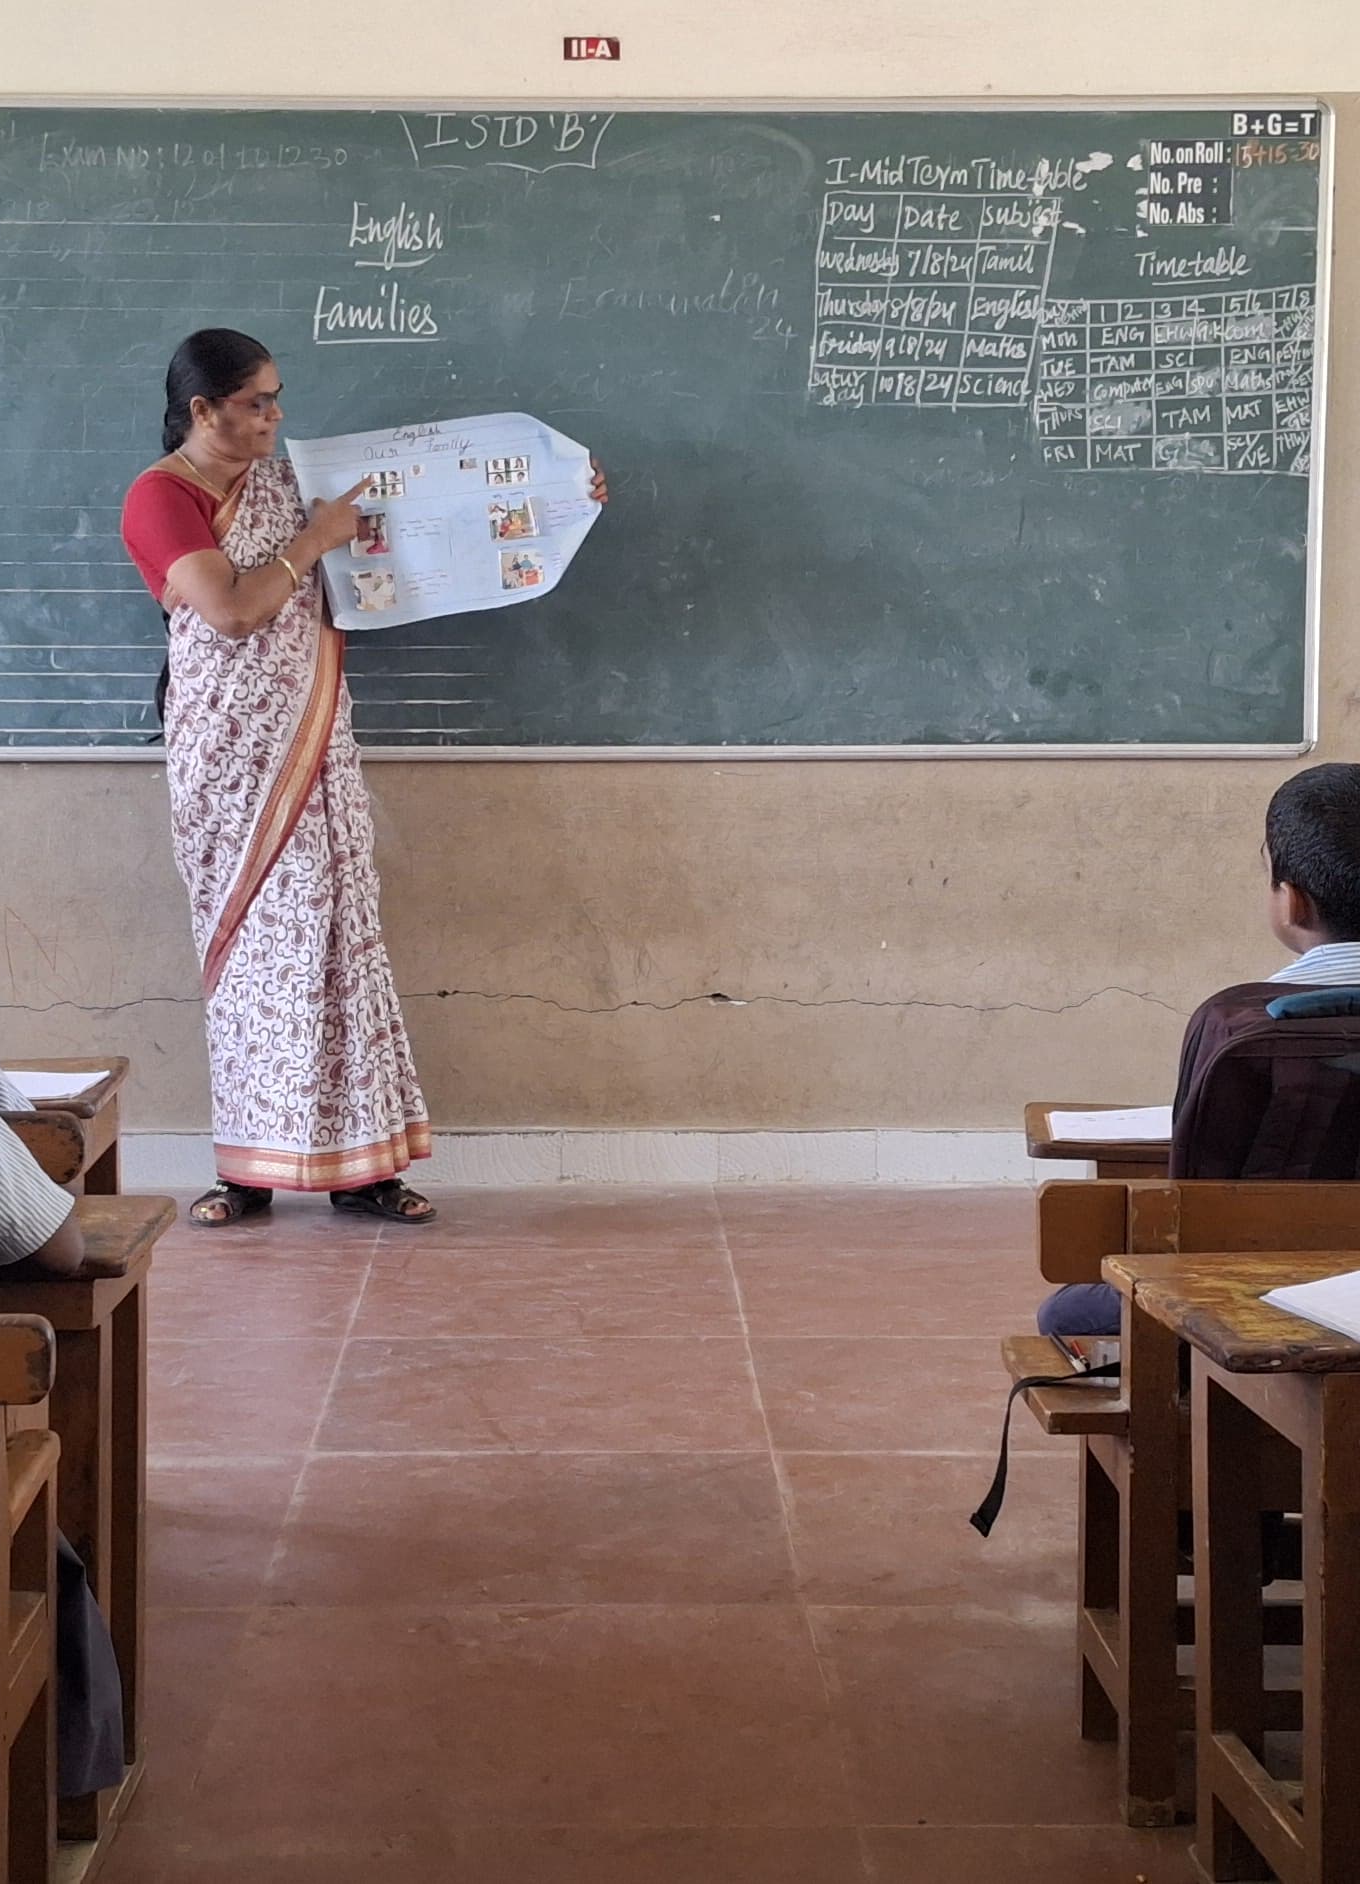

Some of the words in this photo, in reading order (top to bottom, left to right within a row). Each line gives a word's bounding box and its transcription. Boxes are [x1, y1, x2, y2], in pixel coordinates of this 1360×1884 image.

[571, 39, 613, 58] II-A
[465, 113, 539, 151] STD
[1176, 147, 1193, 164] on
[1177, 171, 1203, 195] Pre
[827, 202, 875, 232] Day
[904, 206, 964, 231] Date
[1176, 201, 1206, 224] Abs
[349, 200, 444, 271] English
[978, 244, 1035, 274] Tamil
[313, 281, 439, 341] Families
[972, 289, 1041, 331] English
[1123, 303, 1143, 321] 2
[1155, 302, 1172, 319] 3
[1186, 298, 1206, 319] 4
[818, 330, 882, 361] Friday
[966, 334, 1028, 360] Maths
[1101, 325, 1145, 346] ENG
[1090, 352, 1136, 375] TAM
[958, 374, 1033, 398] Science
[1161, 404, 1211, 429] TAM
[1225, 399, 1262, 425] MAT
[1043, 443, 1076, 464] FRI
[1095, 442, 1143, 463] MAT
